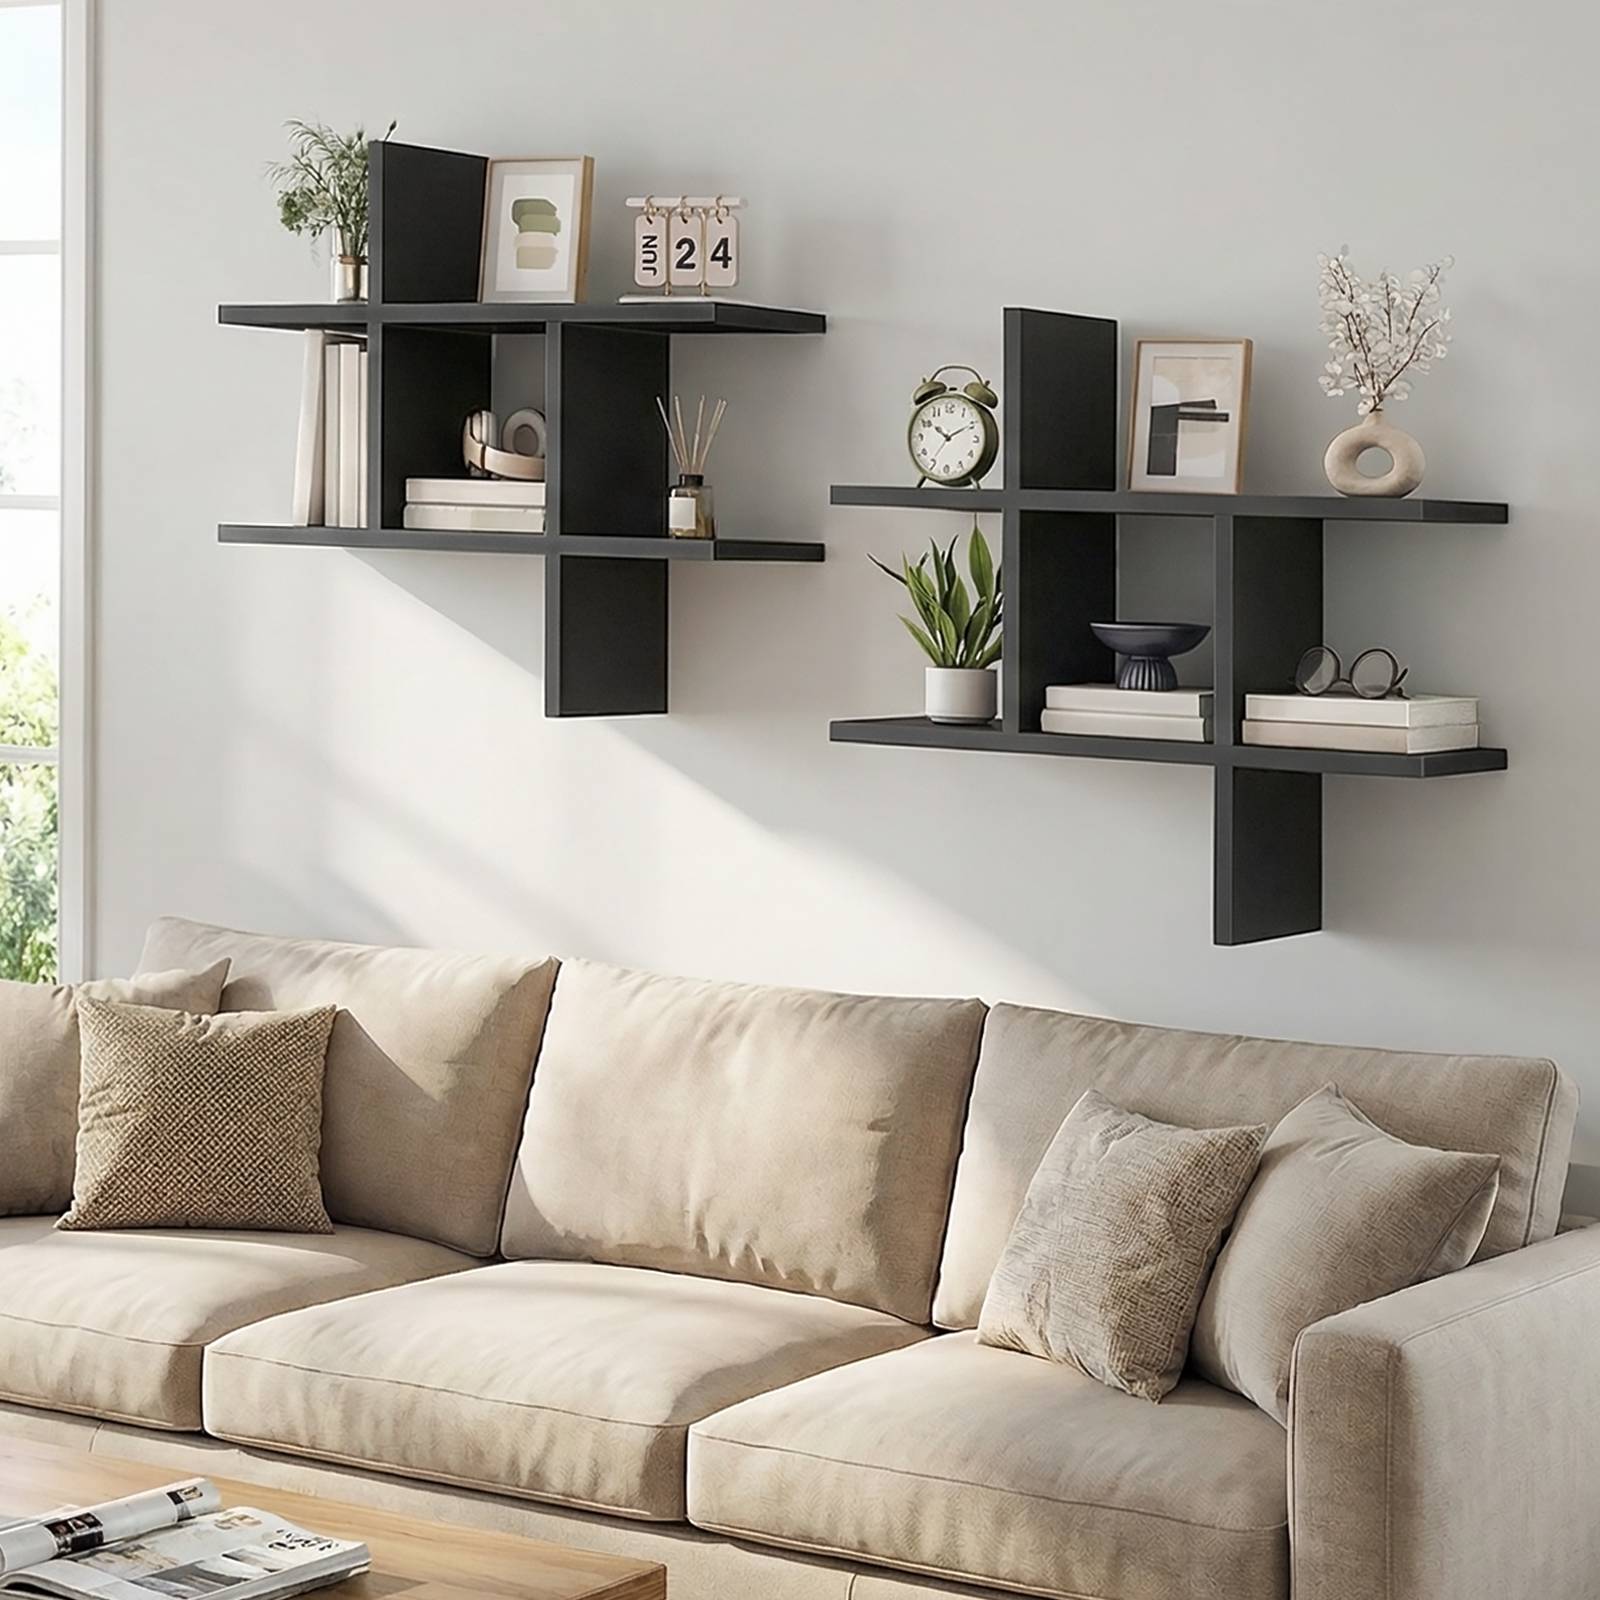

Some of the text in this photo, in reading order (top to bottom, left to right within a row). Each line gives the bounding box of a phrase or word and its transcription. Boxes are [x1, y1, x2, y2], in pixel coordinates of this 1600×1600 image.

[642, 235, 658, 276] JUN
[675, 237, 696, 270] 2
[710, 237, 733, 270] 4
